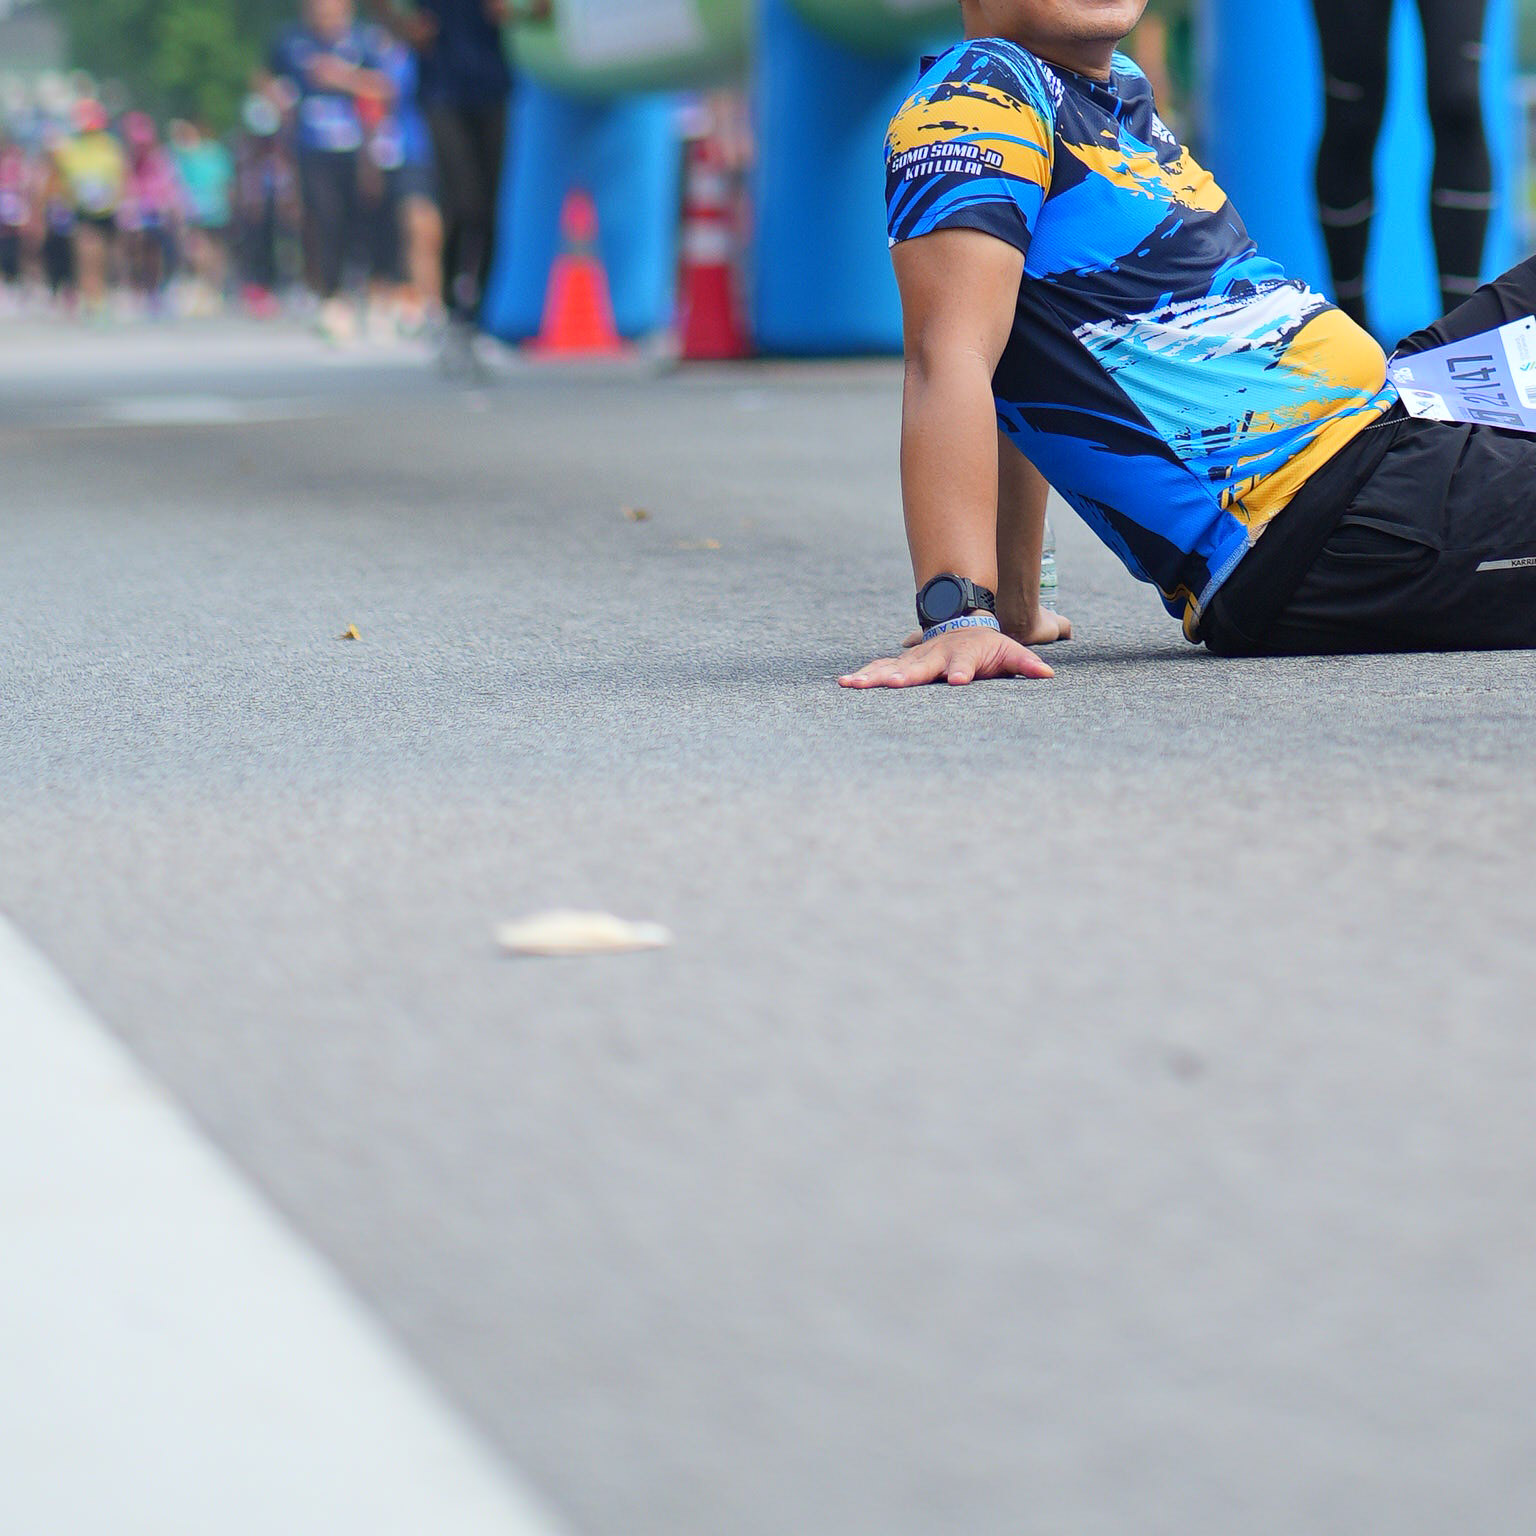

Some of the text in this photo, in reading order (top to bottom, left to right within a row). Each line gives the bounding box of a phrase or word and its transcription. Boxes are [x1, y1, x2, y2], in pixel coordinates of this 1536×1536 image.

[930, 143, 980, 159] SOMO
[938, 623, 947, 633] A
[951, 617, 977, 630] FOR
